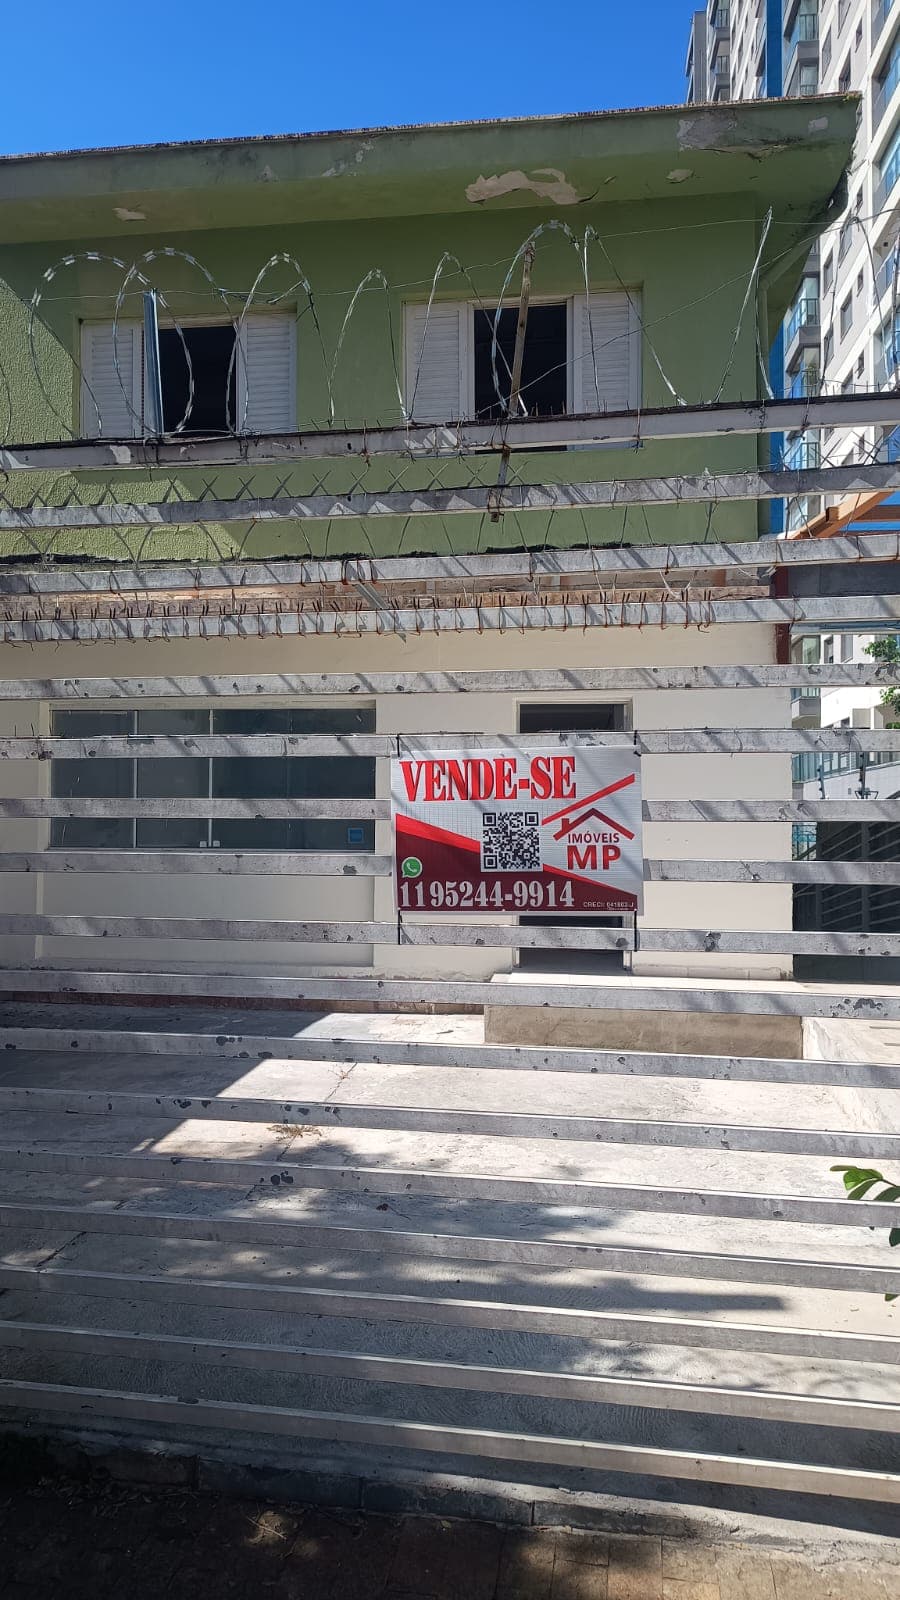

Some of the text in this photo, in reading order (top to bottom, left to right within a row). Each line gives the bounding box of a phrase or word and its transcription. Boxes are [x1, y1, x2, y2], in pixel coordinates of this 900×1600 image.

[399, 756, 576, 802] VENDE-SE
[568, 831, 620, 844] IMÓVEIS
[566, 845, 621, 870] MP
